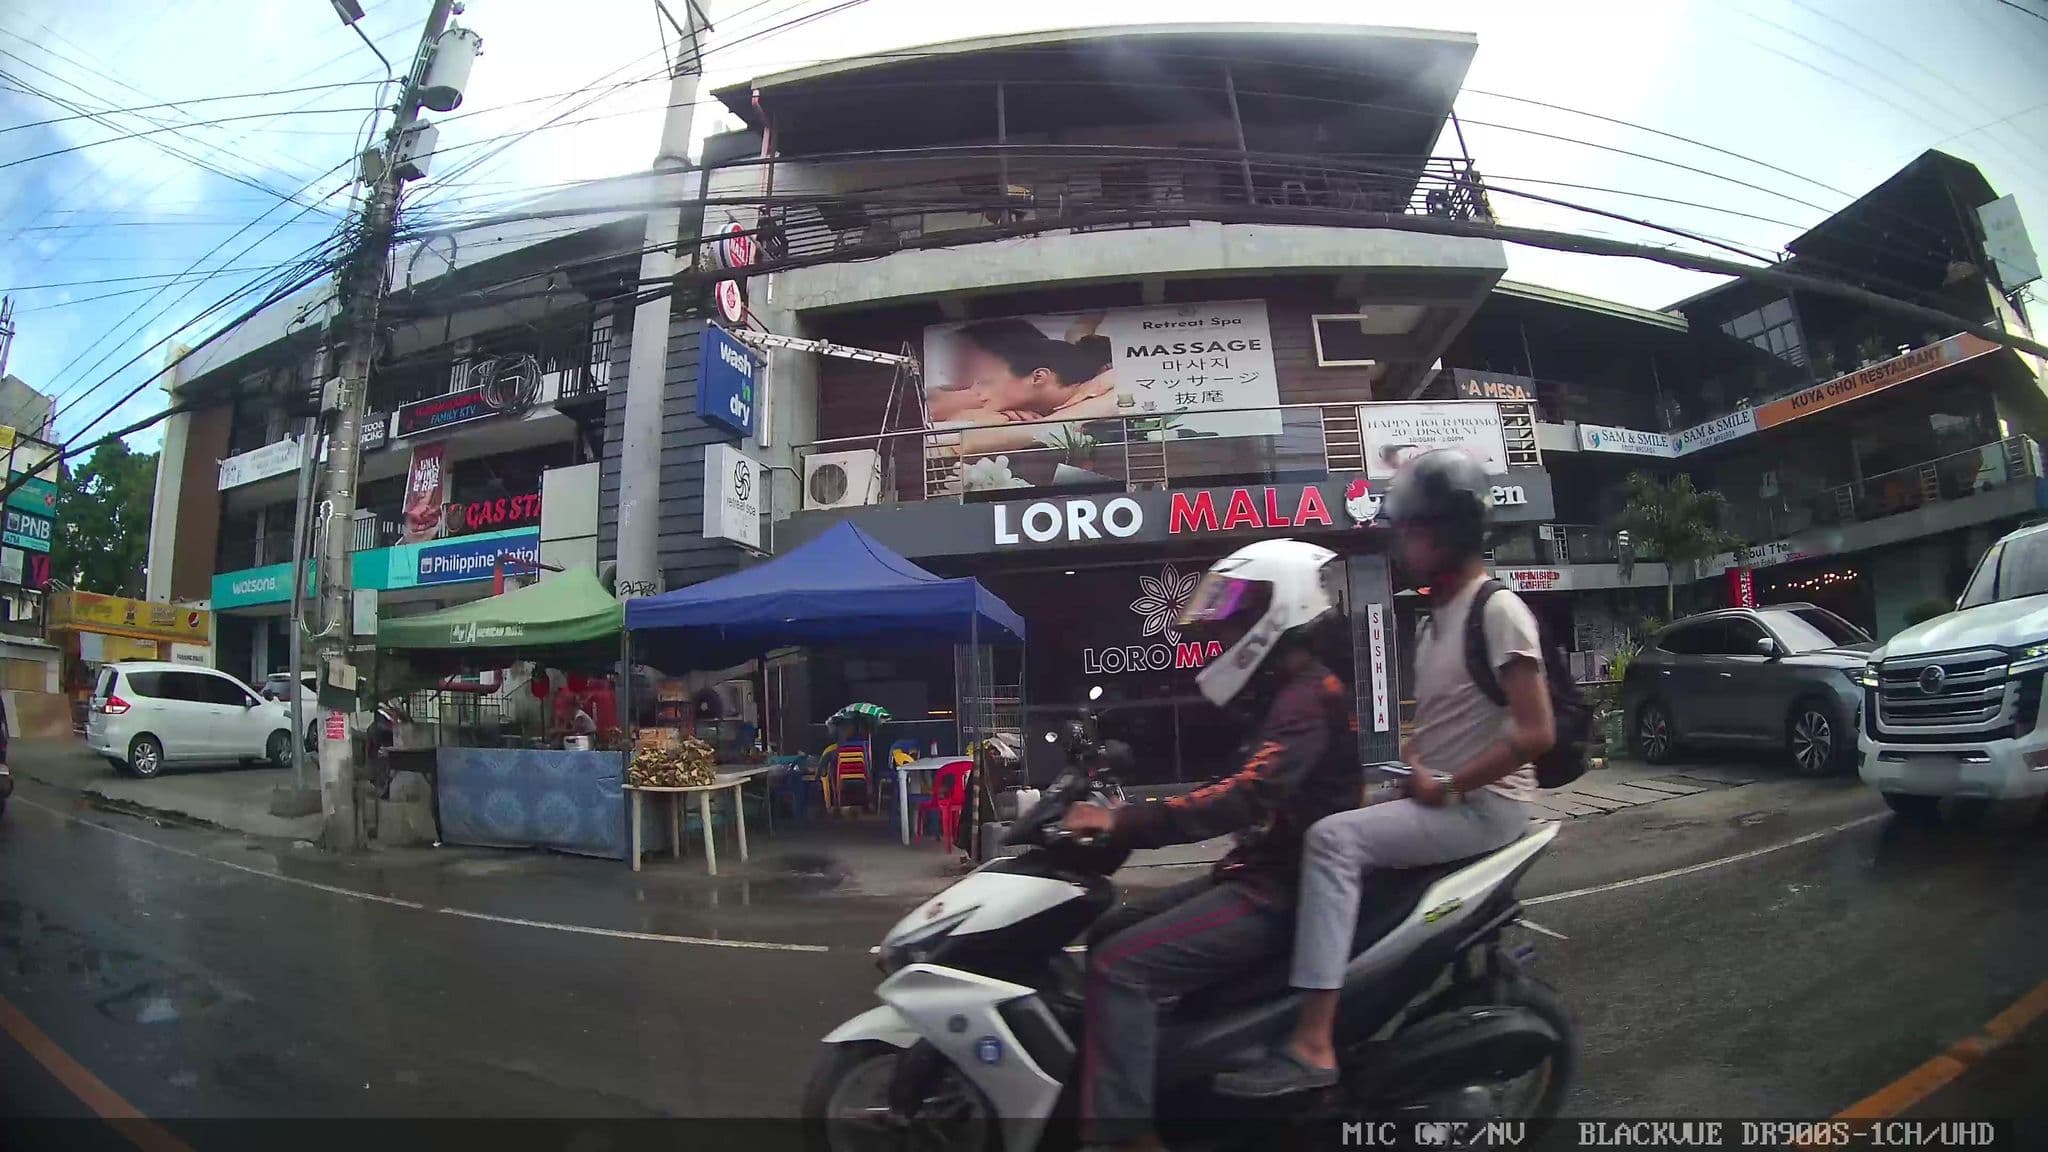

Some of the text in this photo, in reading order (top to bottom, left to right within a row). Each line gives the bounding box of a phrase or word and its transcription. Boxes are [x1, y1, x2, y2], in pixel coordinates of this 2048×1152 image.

[1143, 317, 1242, 330] Retreat Spa
[1126, 339, 1262, 358] MASSAGE
[720, 341, 752, 379] wash
[1162, 357, 1229, 371] 마사지
[1136, 371, 1260, 390] マッサージ
[1791, 346, 1942, 409] KUYA CHOI RESTAURANT
[1468, 380, 1526, 399] A MESA
[729, 393, 750, 427] dry
[1367, 417, 1500, 430] HAPPY HOUR PROMO
[1416, 425, 1478, 437] DISCOUNT
[1684, 411, 1750, 443] SAM & SMILE
[1601, 429, 1669, 447] SAM & SMILE
[994, 485, 1333, 545] LORO MALA
[20, 514, 50, 539] PNB
[434, 552, 495, 574] Philippine
[232, 577, 275, 595] watsons
[1084, 640, 1223, 674] LORO MA
[1372, 612, 1385, 724] SUSHIYA
